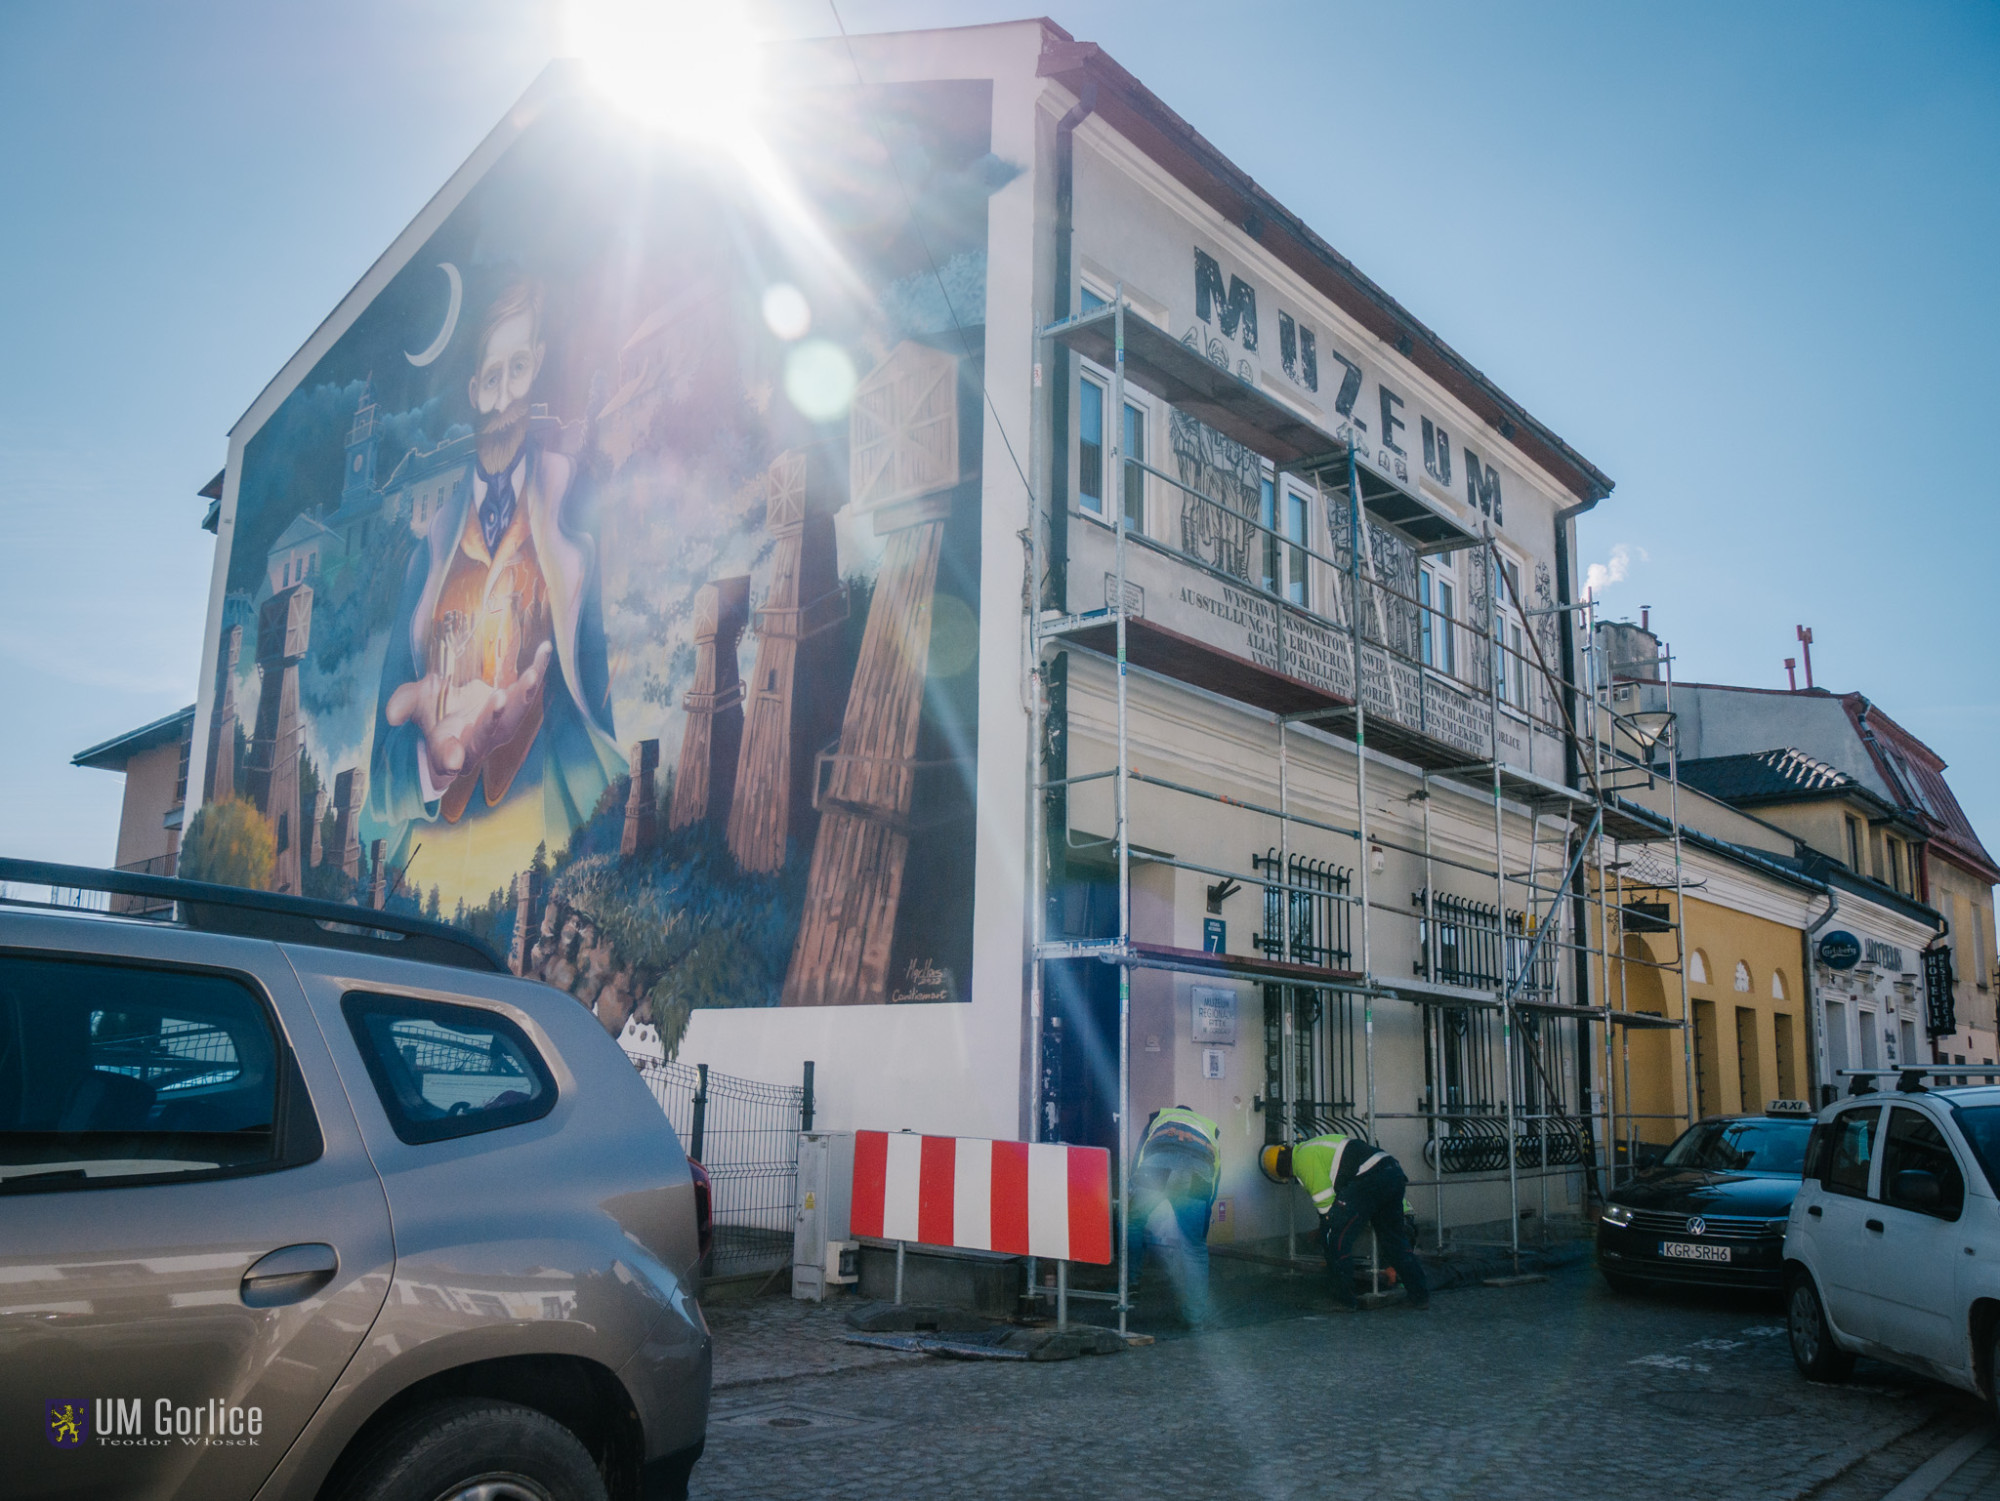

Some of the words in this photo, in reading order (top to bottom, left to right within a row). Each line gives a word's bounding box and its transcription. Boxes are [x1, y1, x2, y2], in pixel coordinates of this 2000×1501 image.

[1194, 246, 1503, 527] MUZEUM
[1179, 587, 1264, 634] AUSSTELLUNG
[1223, 586, 1276, 624] WYSTAWA
[1280, 613, 1348, 655] KSPONATÓW
[1211, 935, 1219, 955] 7
[1821, 944, 1857, 958] Carlsberg
[1928, 956, 1940, 1027] HOTELIK
[1772, 1101, 1803, 1110] TAXI
[1666, 1243, 1690, 1258] KGR
[1695, 1246, 1728, 1261] 5RH6
